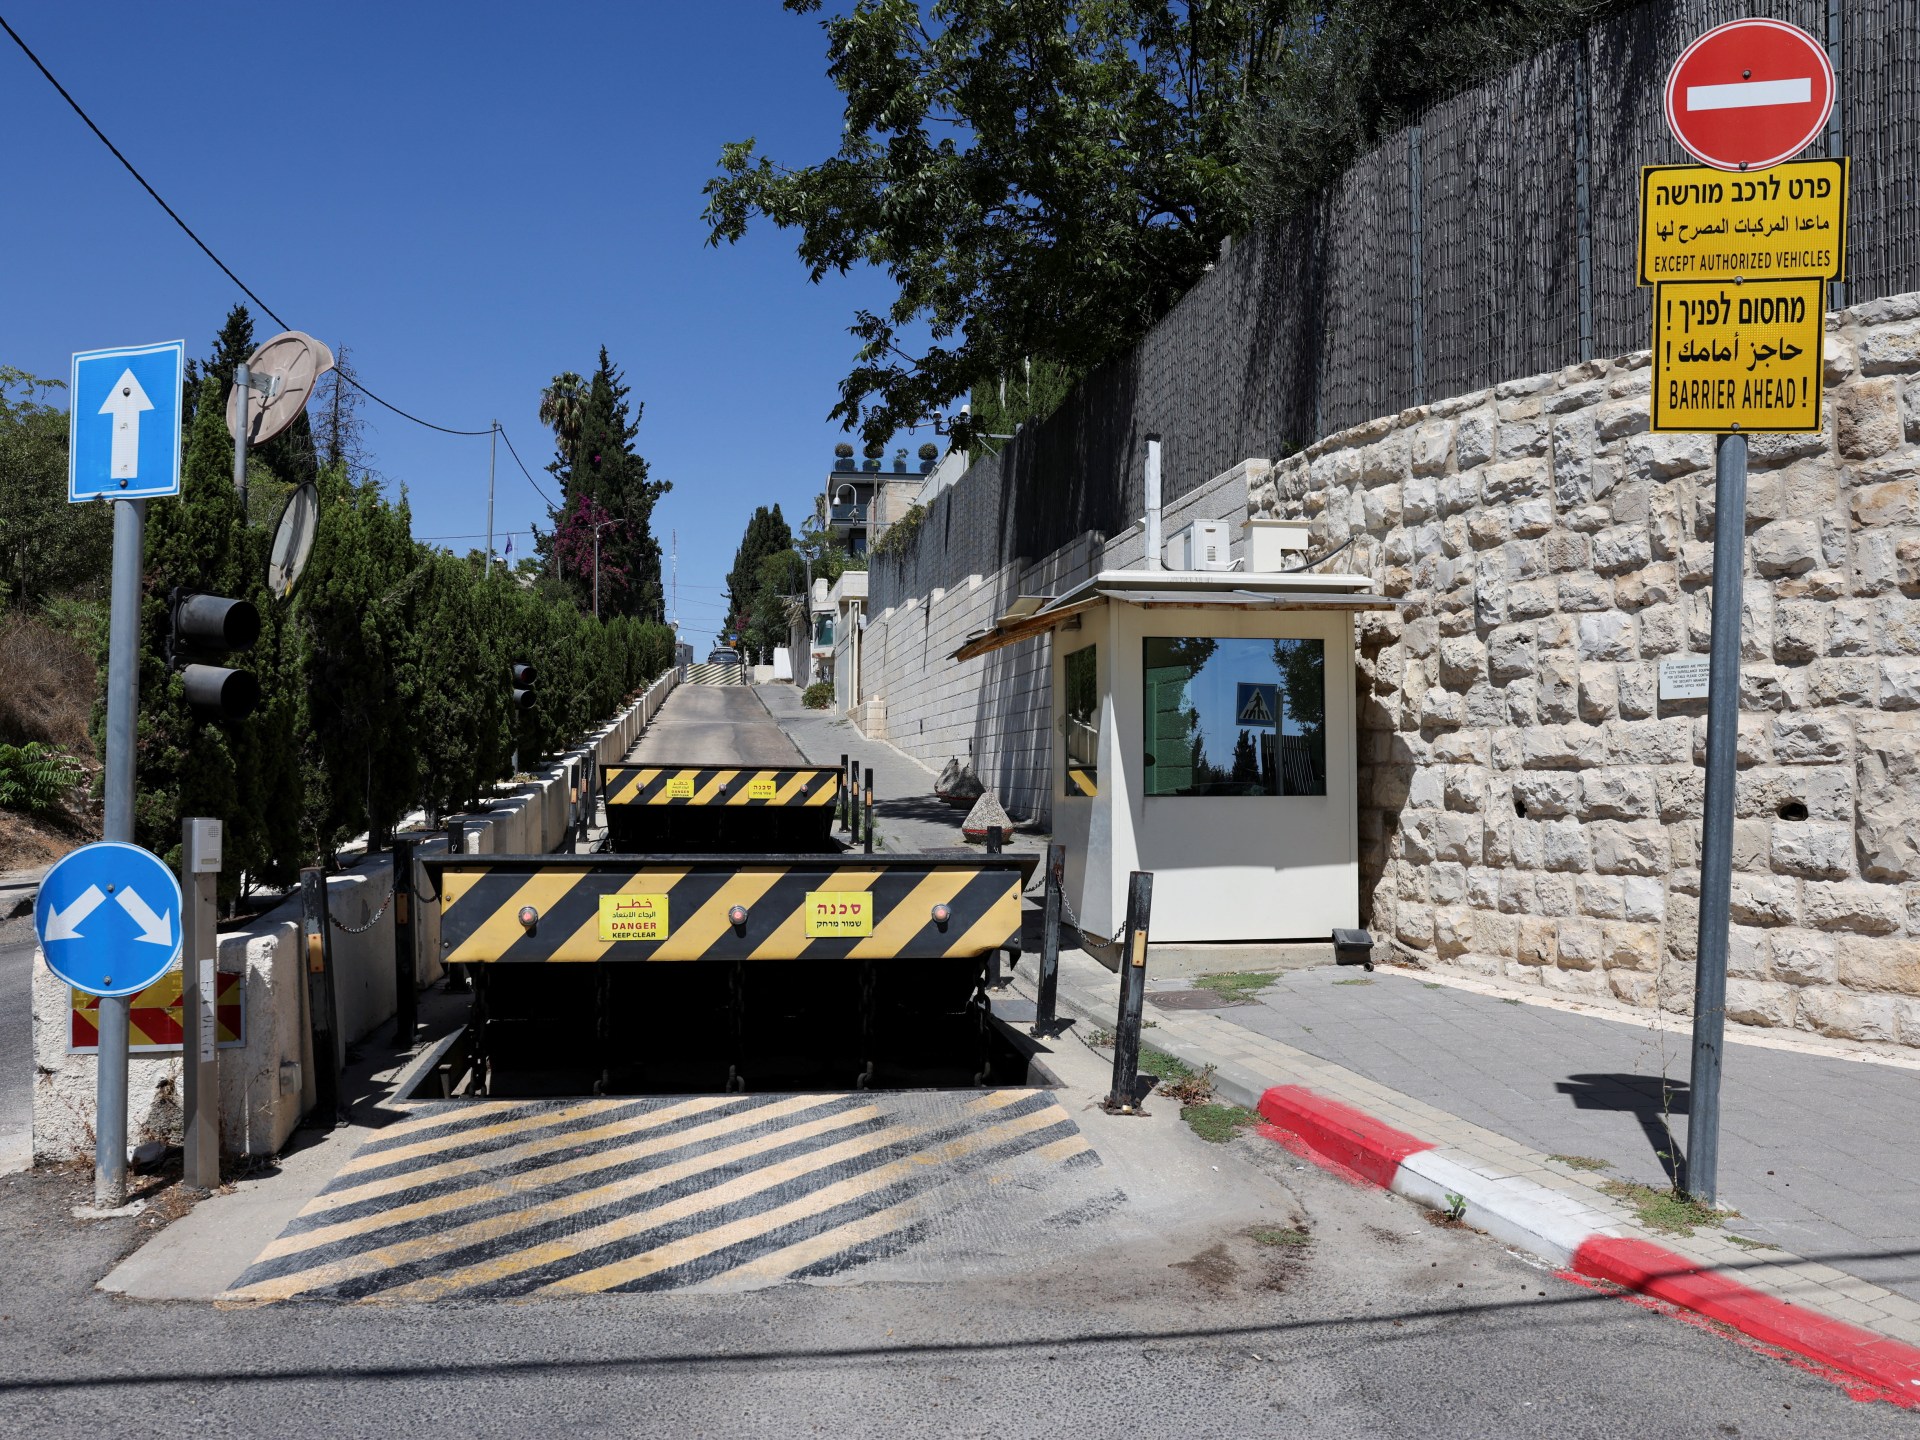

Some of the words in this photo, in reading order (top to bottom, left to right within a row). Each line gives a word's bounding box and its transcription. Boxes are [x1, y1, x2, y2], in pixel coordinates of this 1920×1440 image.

[1656, 182, 1723, 206] מורשה
[1731, 174, 1781, 202] לרכב
[1789, 177, 1831, 200] פרט
[1656, 220, 1674, 242] لها
[1678, 218, 1728, 243] المصرح
[1734, 215, 1788, 238] المركبات
[1795, 214, 1830, 232] ماعدا
[1654, 255, 1696, 273] EXCEPT
[1700, 252, 1772, 271] AUTHORIZED
[1776, 250, 1831, 269] VEHICLES
[1679, 291, 1731, 333] לפניך
[1739, 296, 1805, 325] מחסום
[1678, 332, 1739, 362] أمامك
[1746, 337, 1803, 371] حاجز
[1669, 379, 1735, 409] BARRIER
[1742, 378, 1796, 409] AHEAD
[817, 903, 861, 915] סכנה
[612, 922, 656, 930] DANGER
[816, 920, 839, 928] מרחק
